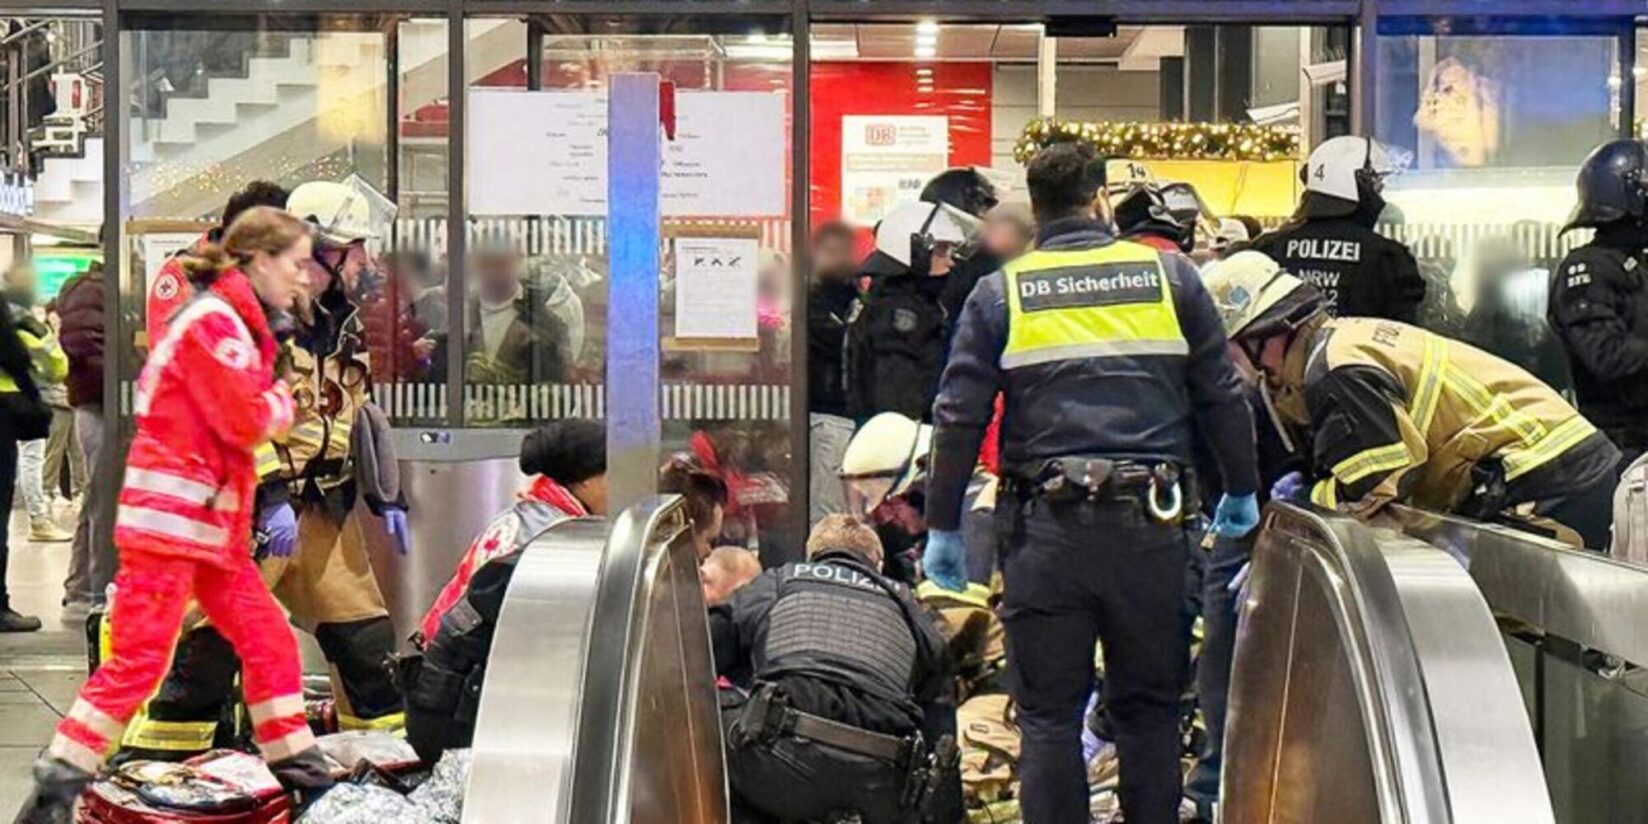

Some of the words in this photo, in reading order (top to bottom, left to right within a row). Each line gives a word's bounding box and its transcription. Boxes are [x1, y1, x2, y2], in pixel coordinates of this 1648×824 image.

[868, 125, 893, 143] DB
[1313, 163, 1325, 181] 4
[1286, 238, 1361, 262] POLIZEI
[1020, 280, 1051, 298] DB
[1056, 271, 1159, 294] Sicherheit
[1298, 268, 1341, 288] NRW
